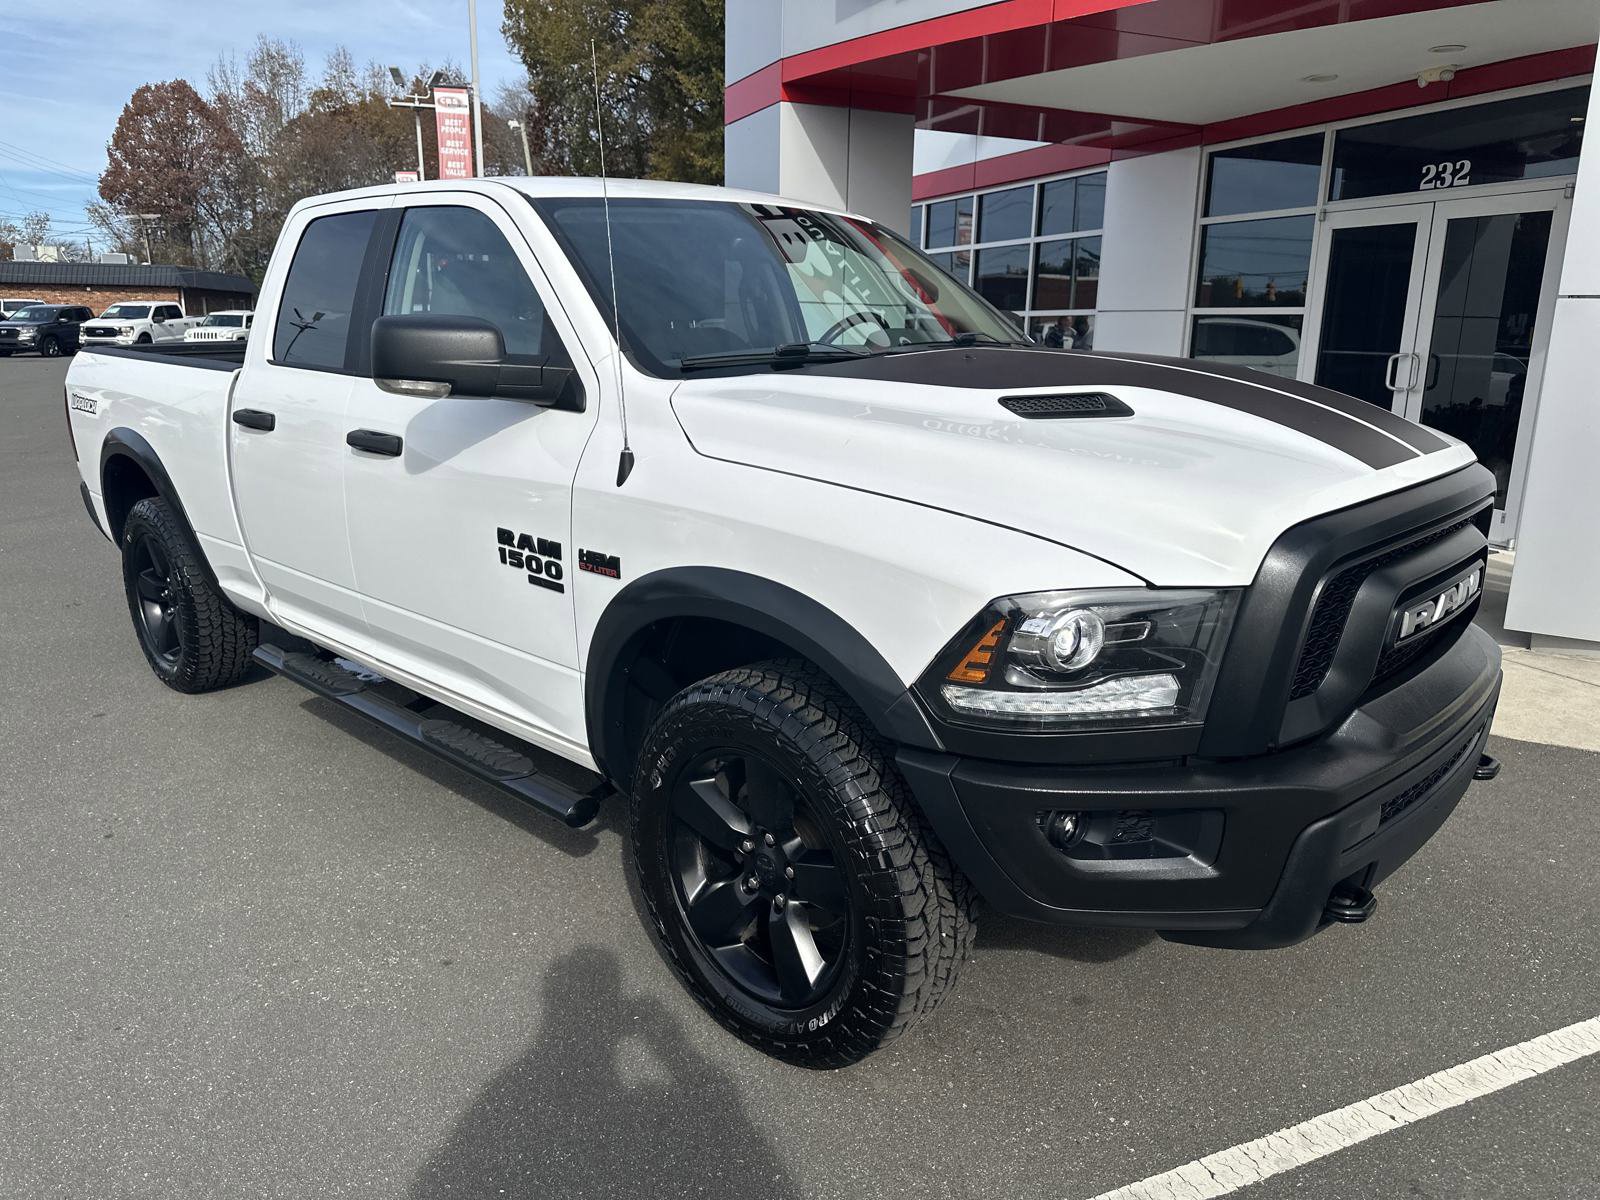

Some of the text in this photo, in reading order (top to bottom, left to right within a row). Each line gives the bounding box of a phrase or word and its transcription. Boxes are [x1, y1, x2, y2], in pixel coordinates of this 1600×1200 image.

[440, 147, 469, 155] SERVICE
[447, 161, 465, 169] BEST
[1420, 160, 1471, 190] 232
[497, 527, 562, 561] RAM
[498, 547, 563, 580] 1500
[1400, 569, 1480, 638] RAM
